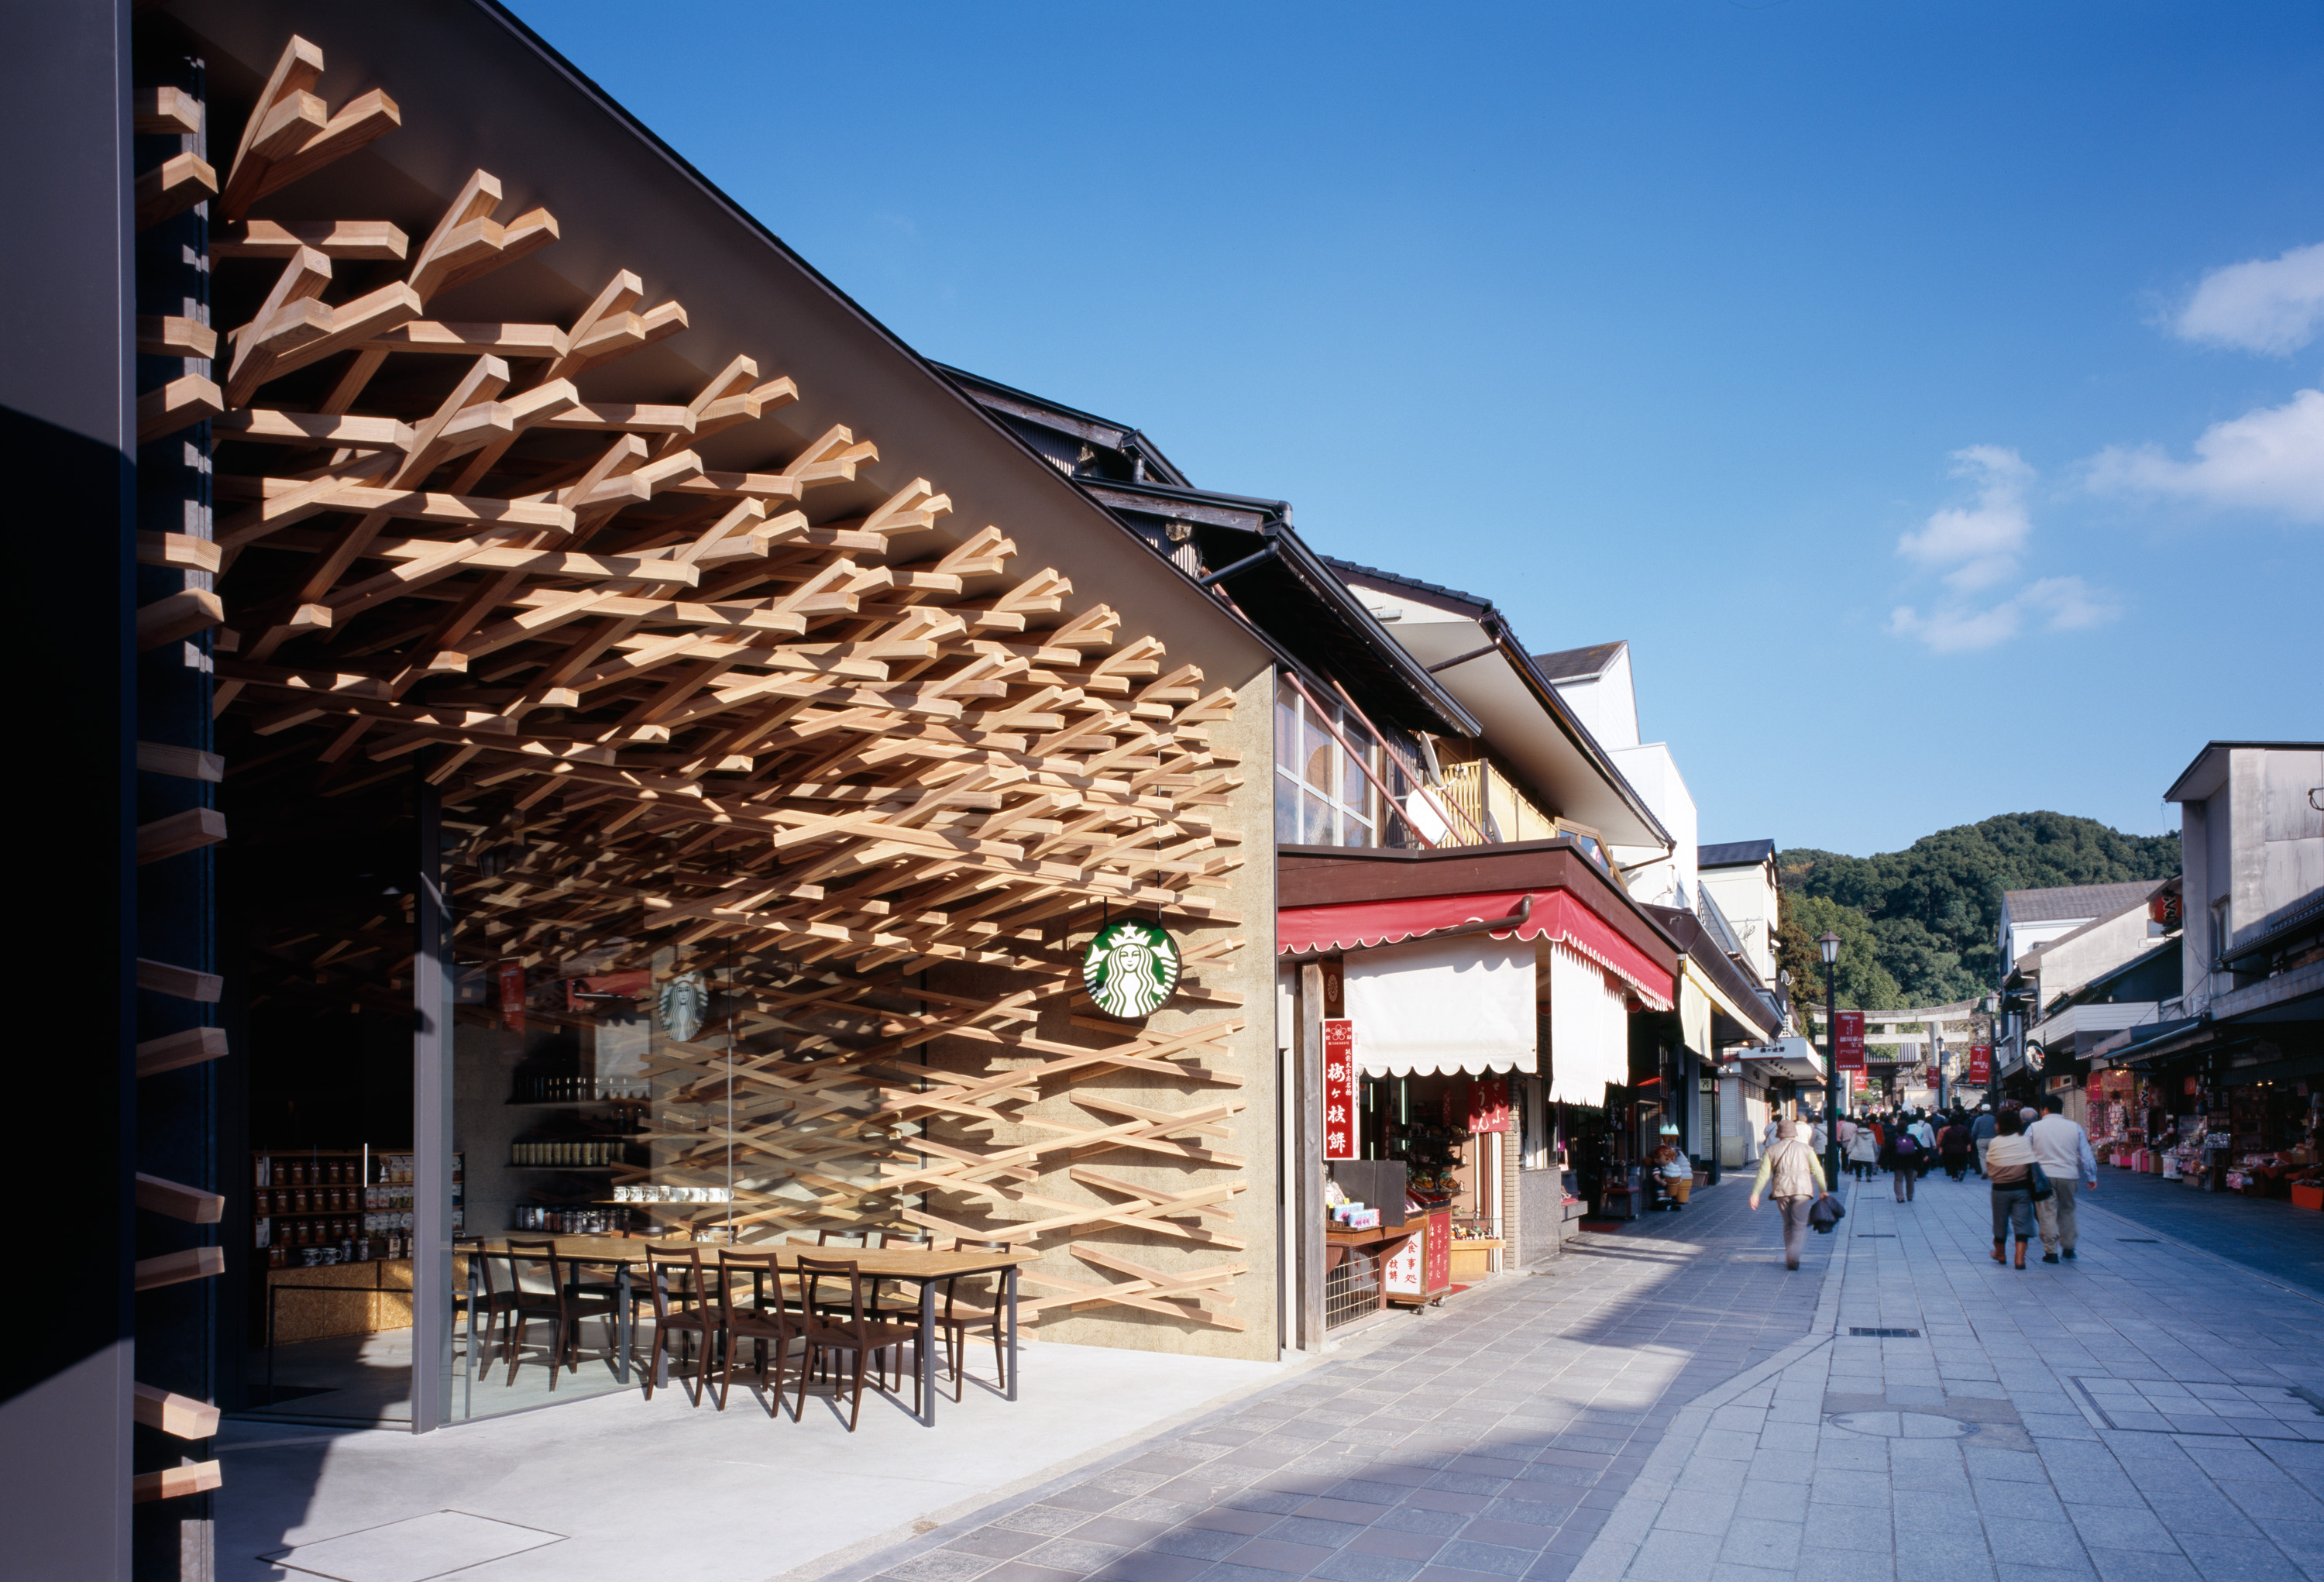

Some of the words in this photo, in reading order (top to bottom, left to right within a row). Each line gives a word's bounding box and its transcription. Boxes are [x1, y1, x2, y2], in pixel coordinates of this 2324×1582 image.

[1327, 1062, 1346, 1154] 梅ヶ枝餅
[1477, 1086, 1490, 1131] うどん
